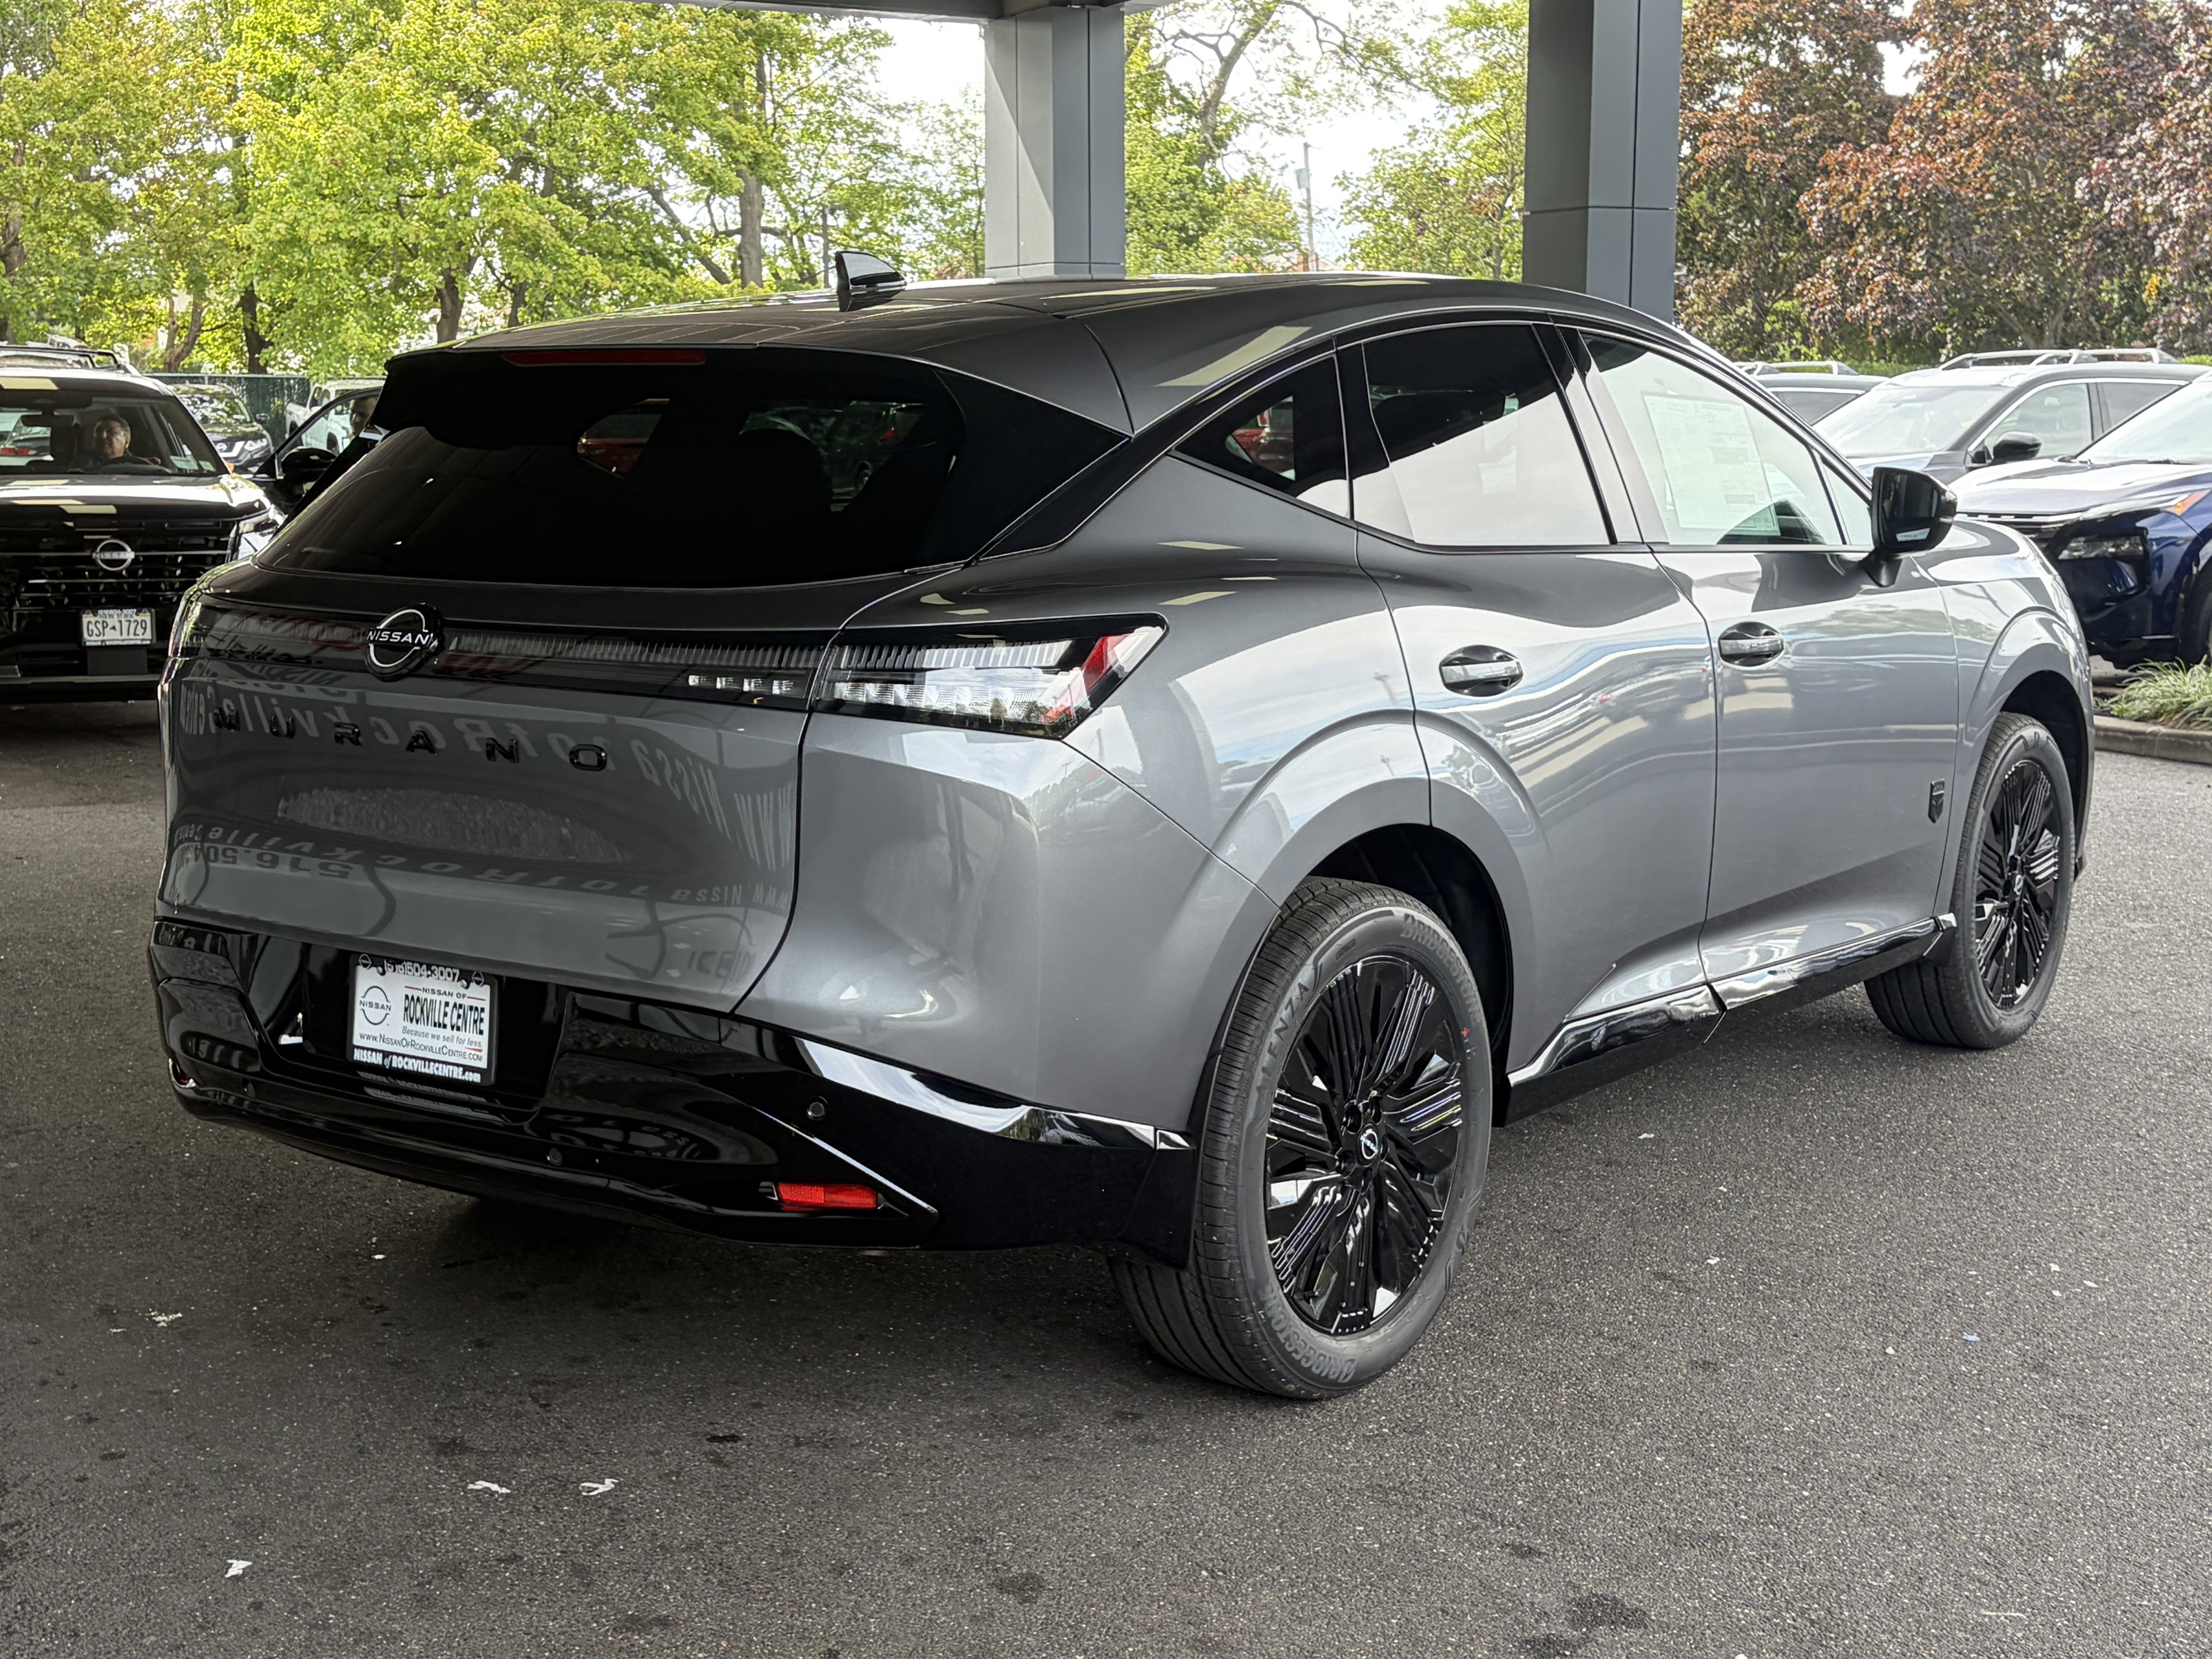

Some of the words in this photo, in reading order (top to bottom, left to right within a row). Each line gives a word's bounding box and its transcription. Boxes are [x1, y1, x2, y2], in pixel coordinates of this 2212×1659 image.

[367, 630, 429, 645] NISSAN
[214, 707, 608, 771] MURANO
[422, 987, 454, 998] NISSAN
[359, 1000, 392, 1012] NISSAN
[403, 993, 450, 1029] ROCKVILLE
[450, 1001, 485, 1036] CENTRE
[402, 1025, 429, 1039] Because
[442, 1034, 454, 1043] sell
[1255, 982, 1309, 1100] ALENZA
[354, 1048, 383, 1065] NISSAN
[384, 1054, 391, 1069] of
[391, 1054, 481, 1083] ROCKVILLECENTRE.com
